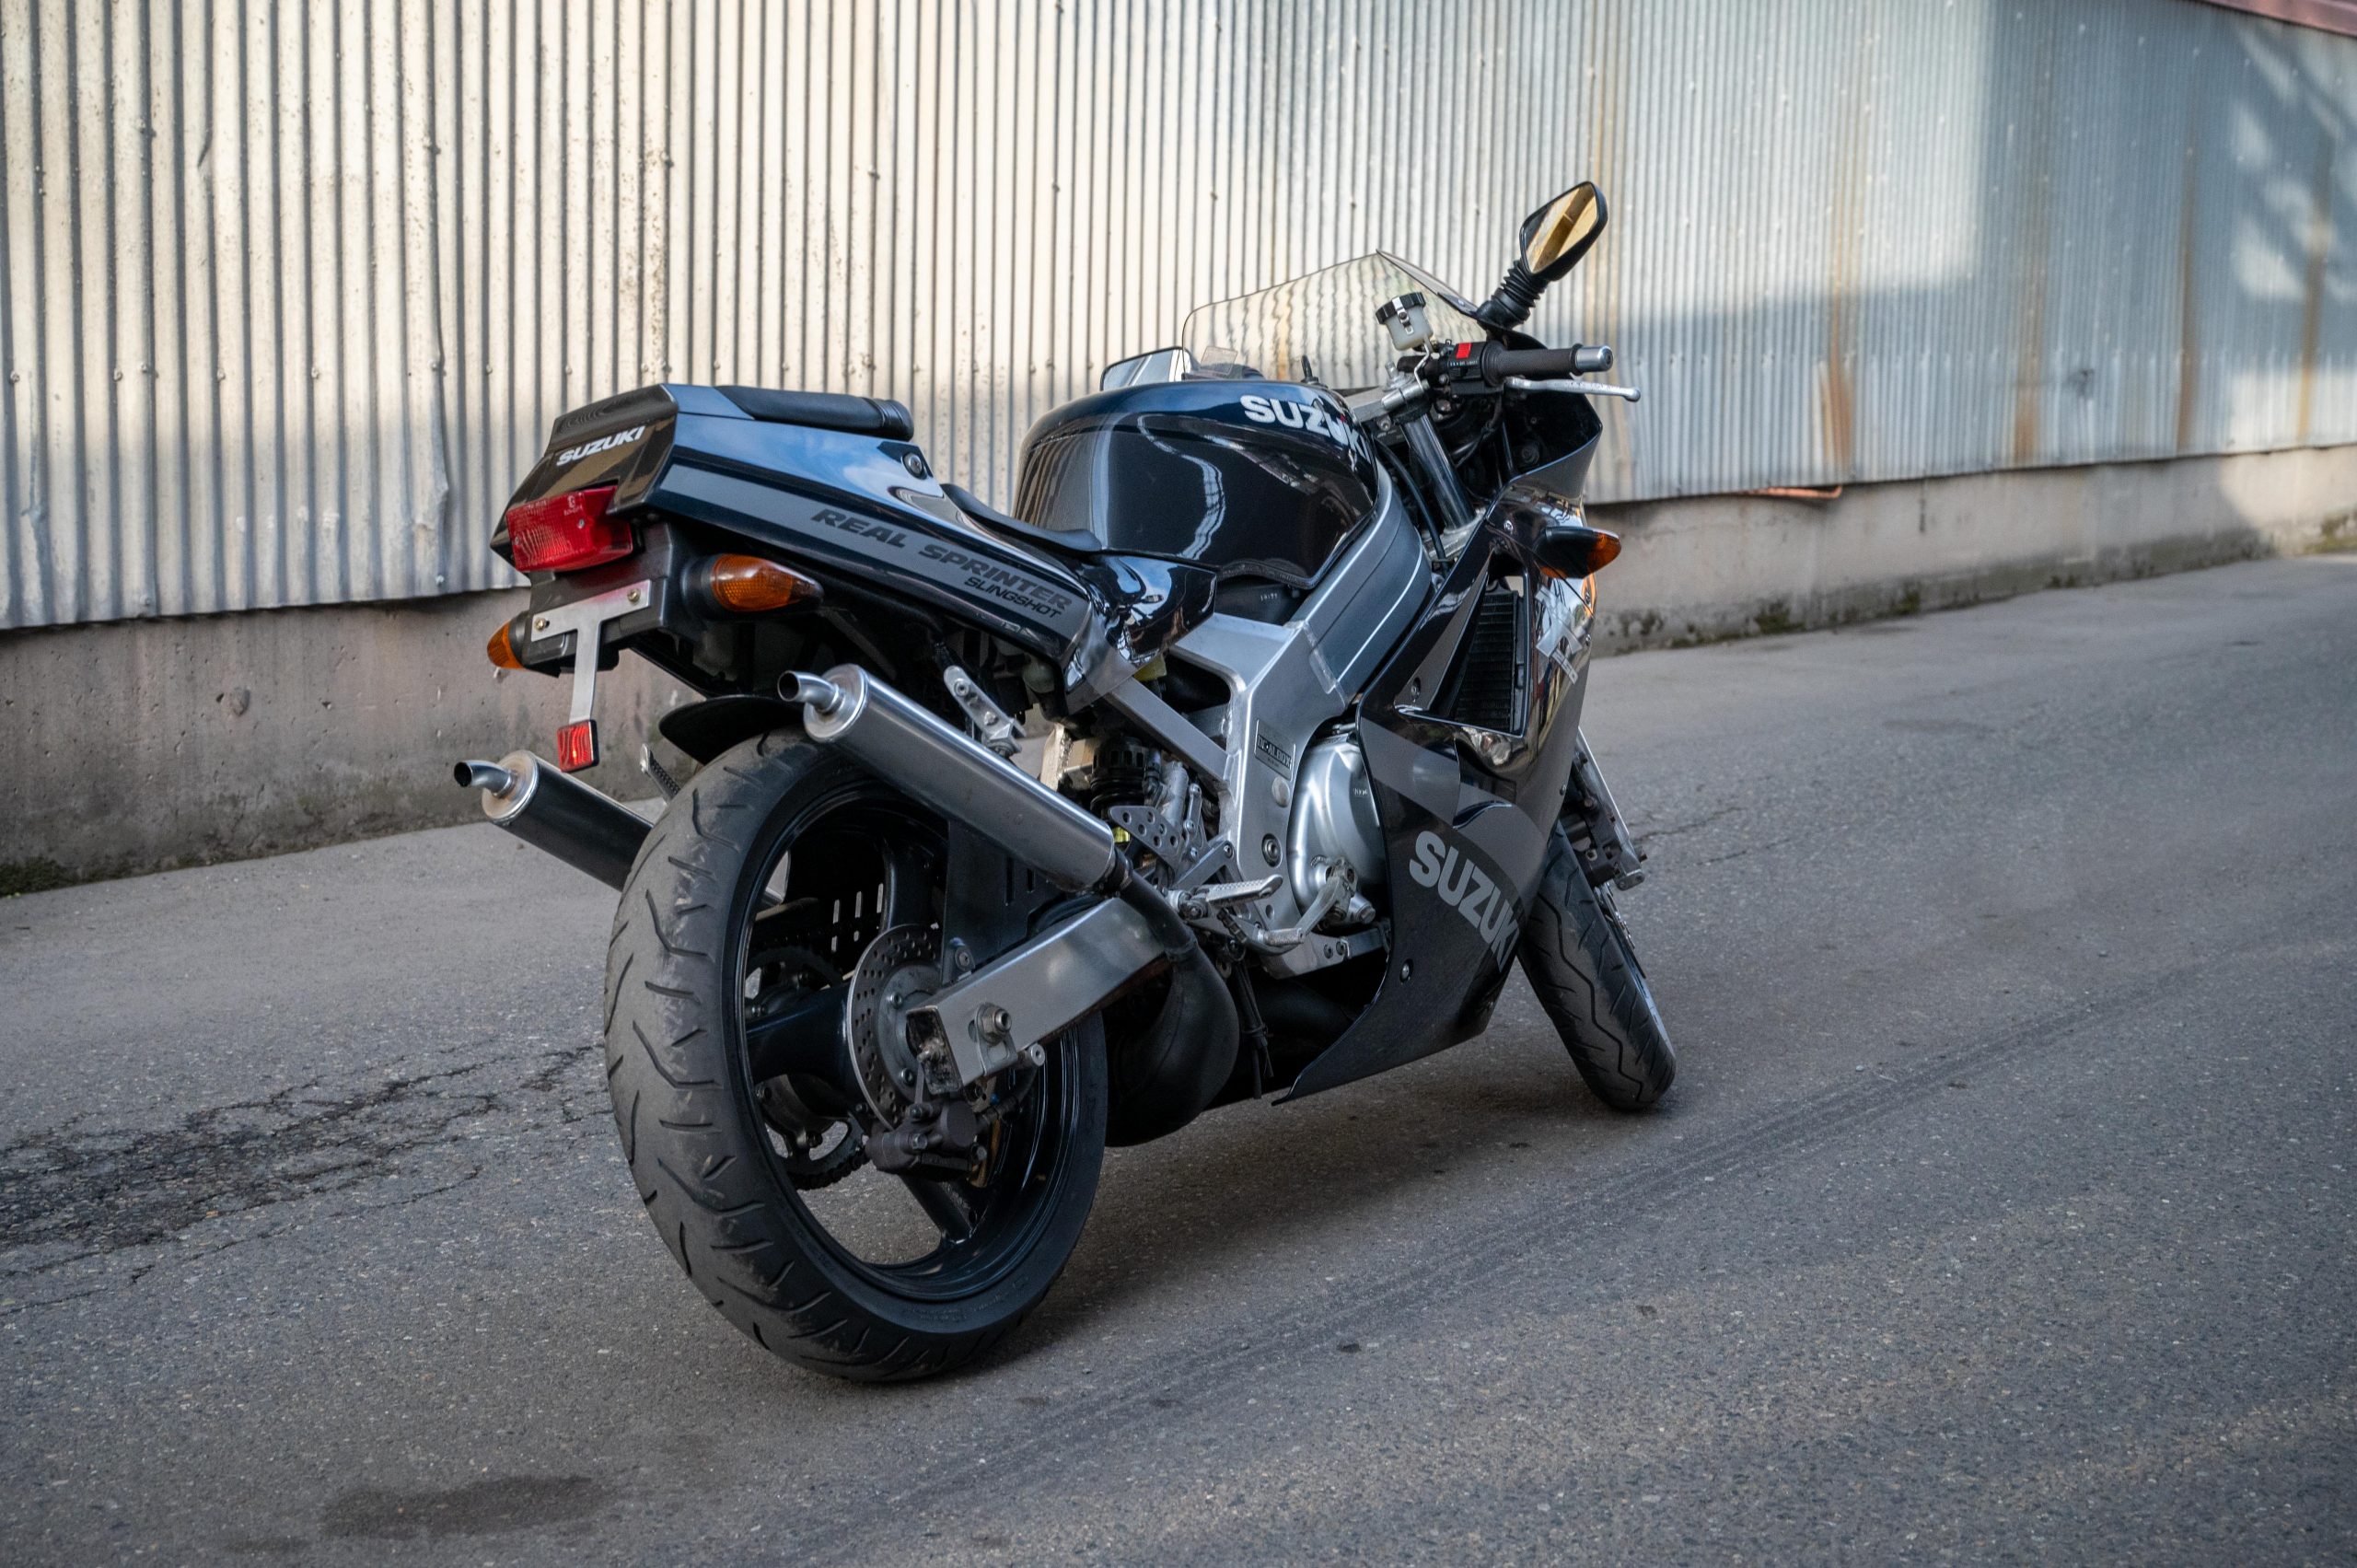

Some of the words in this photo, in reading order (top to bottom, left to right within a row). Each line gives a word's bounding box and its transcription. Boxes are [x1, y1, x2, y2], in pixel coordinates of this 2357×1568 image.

[556, 425, 645, 466] SUZUKI
[1240, 395, 1372, 464] SUZUKI
[811, 509, 908, 549] REAL
[918, 543, 1074, 611] SPRINTER
[964, 575, 1063, 620] SLINGSHOT
[1409, 830, 1520, 973] SUZUKI
